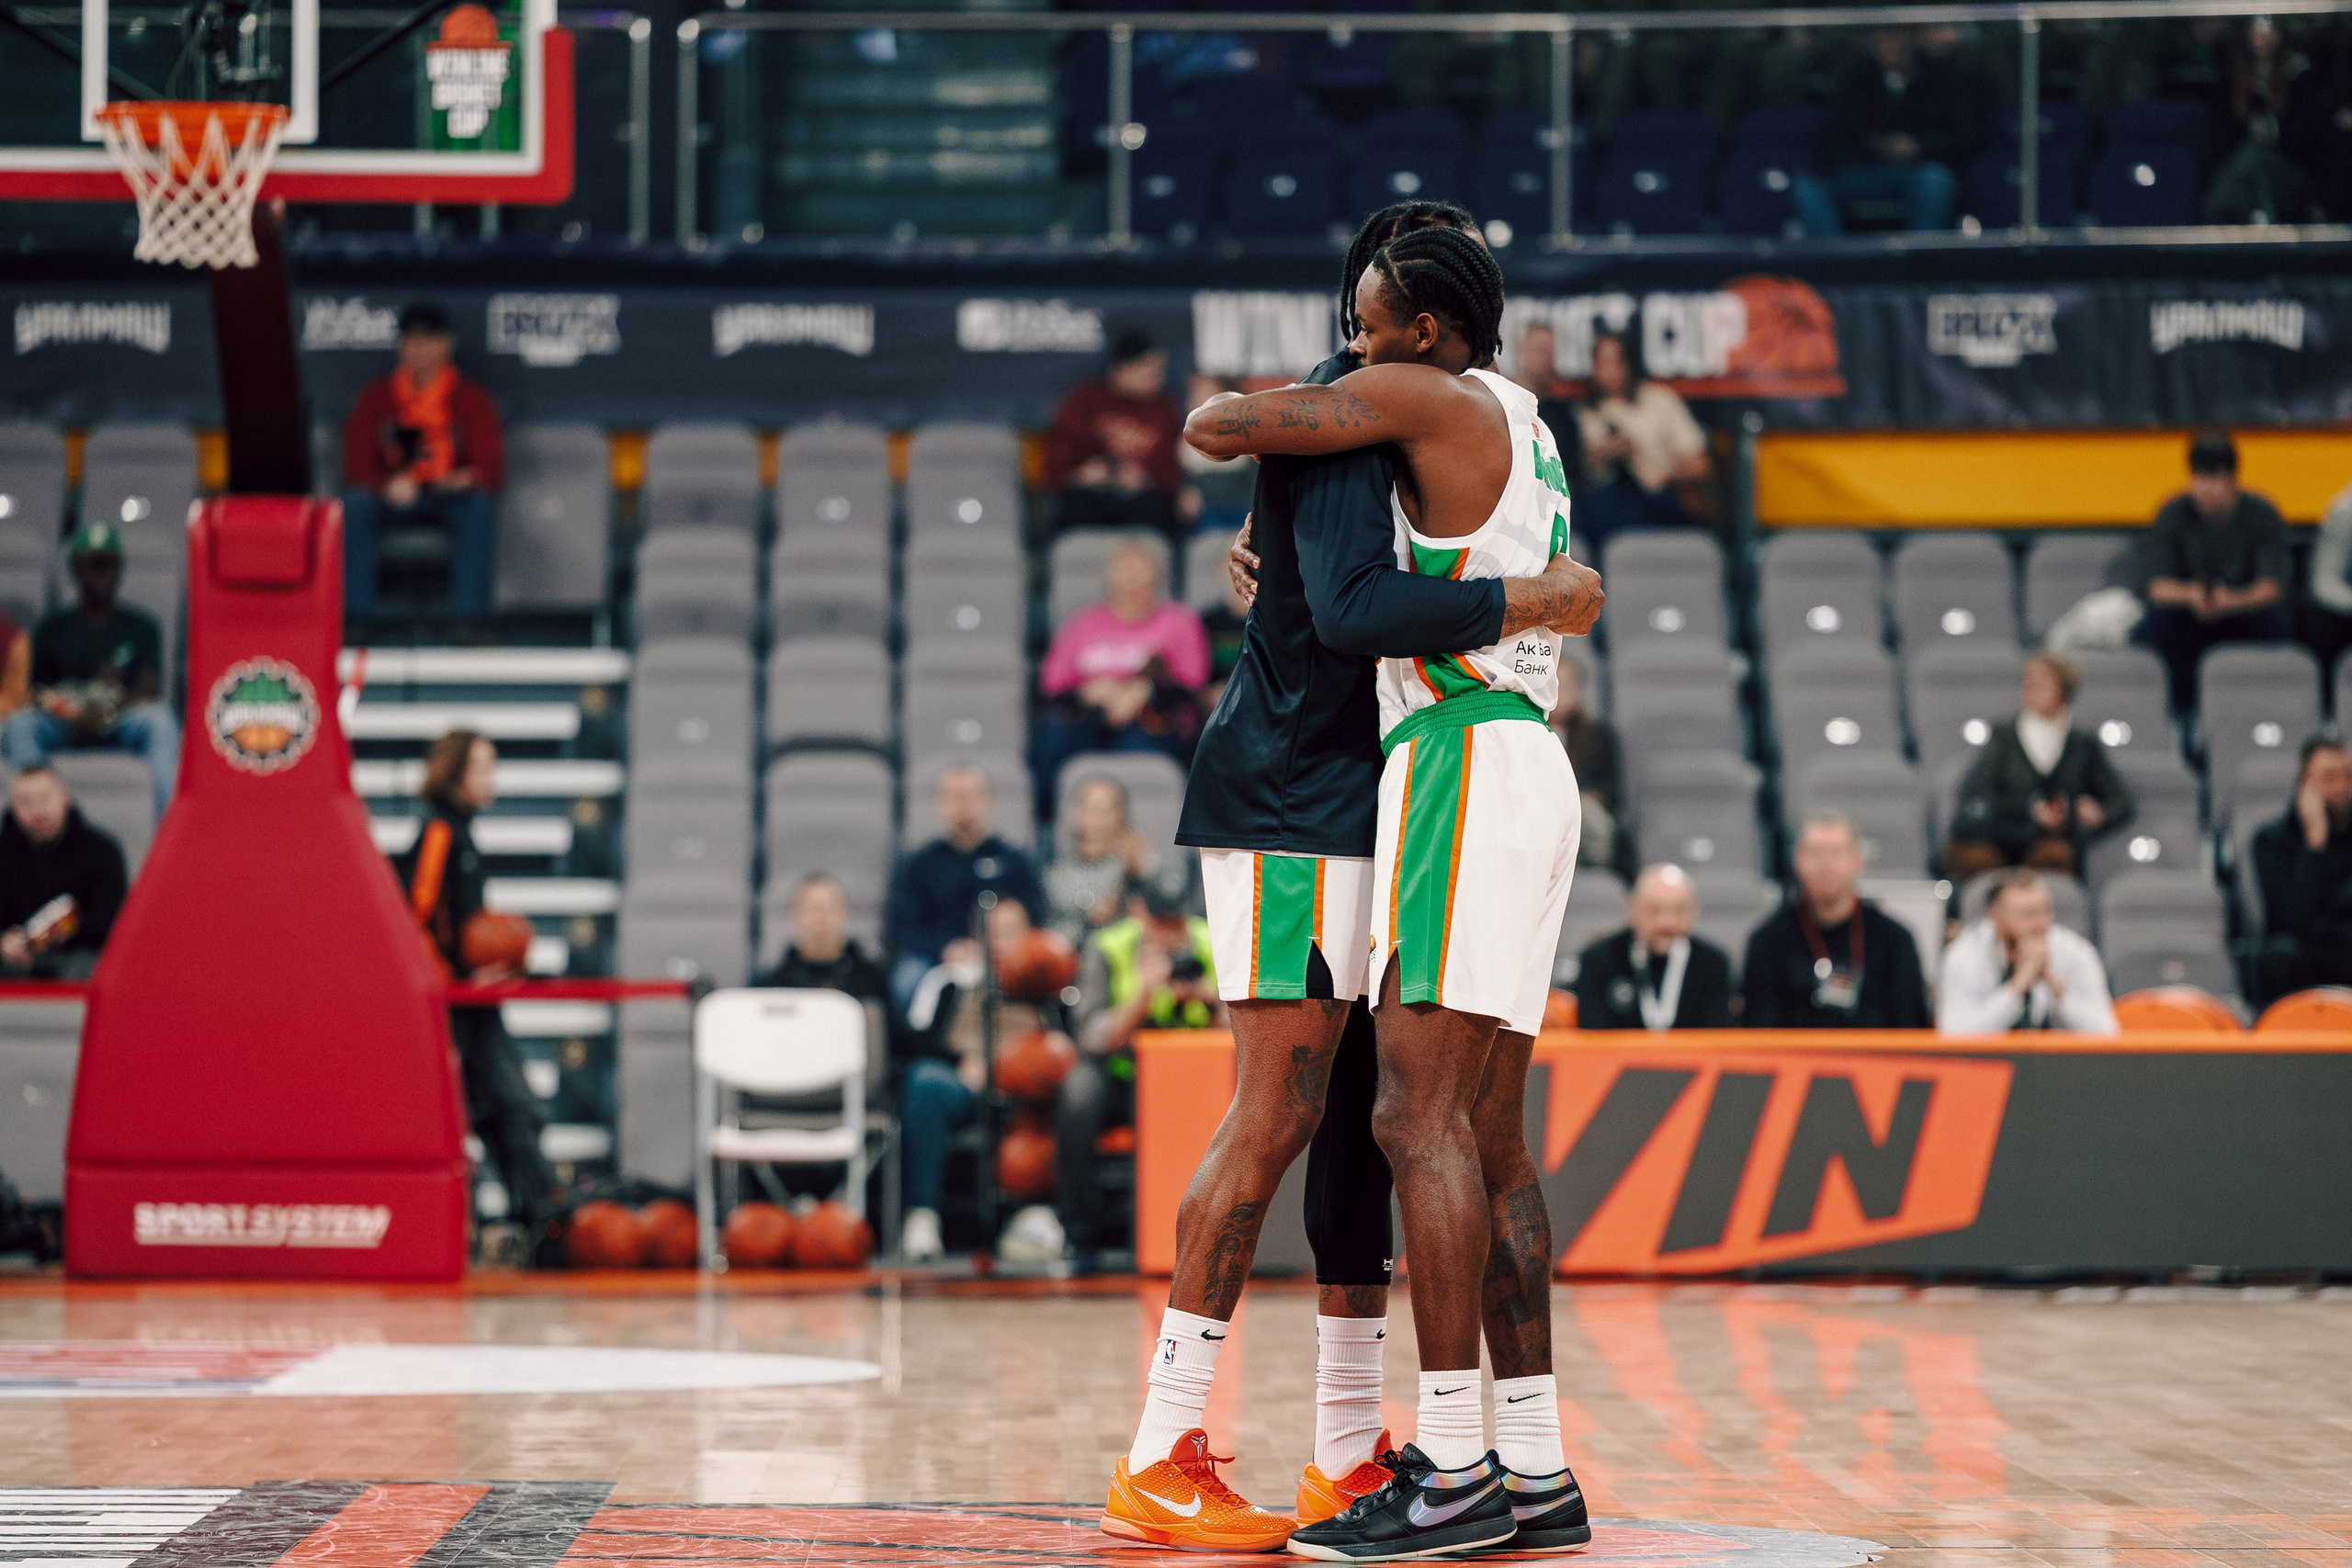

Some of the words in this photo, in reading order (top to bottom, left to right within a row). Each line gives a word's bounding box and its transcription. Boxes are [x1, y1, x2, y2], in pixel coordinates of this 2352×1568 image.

[1642, 290, 1747, 378] CUP
[1516, 640, 1536, 655] Ак
[1514, 659, 1549, 675] Банк
